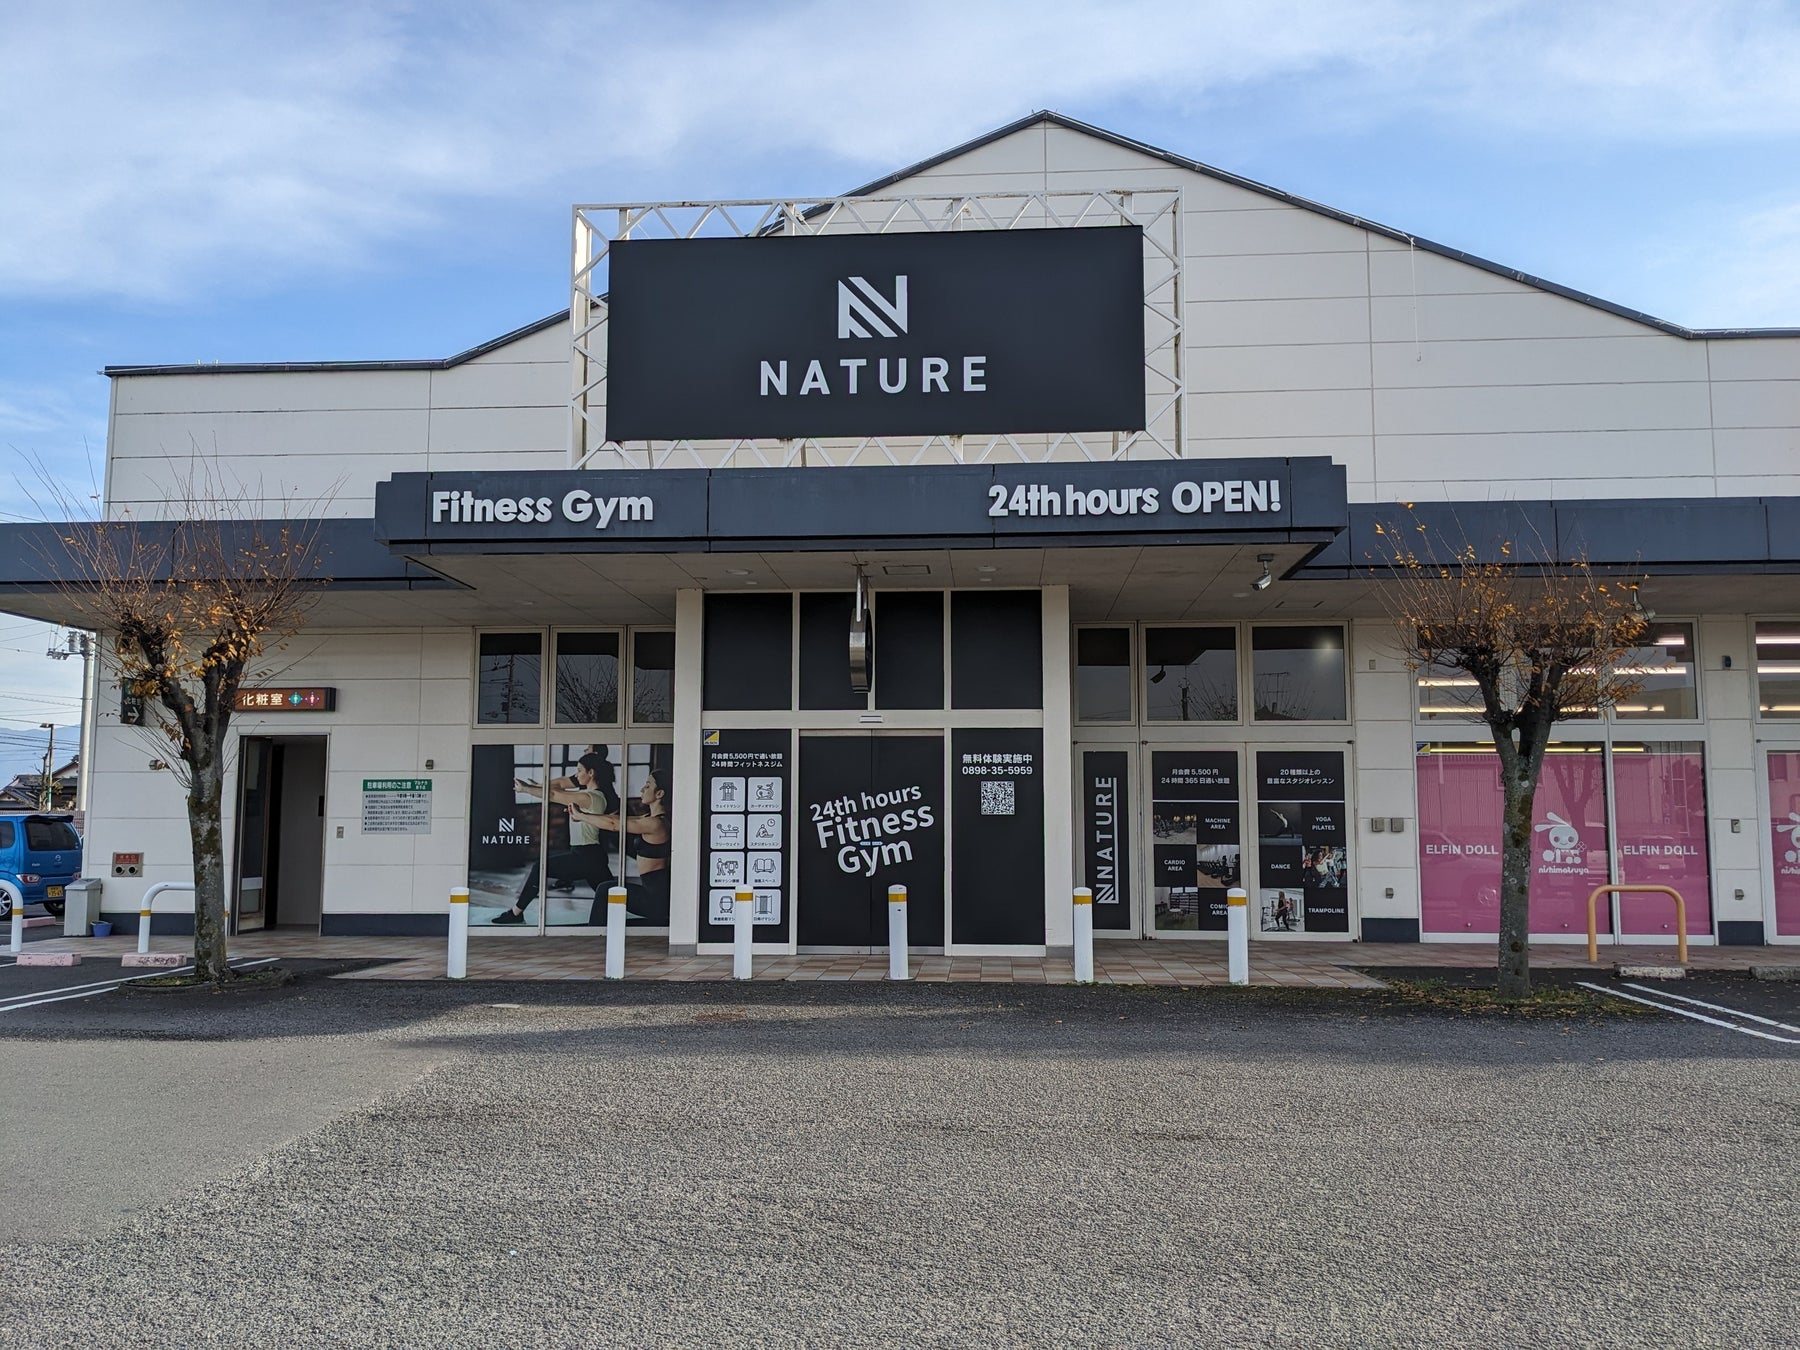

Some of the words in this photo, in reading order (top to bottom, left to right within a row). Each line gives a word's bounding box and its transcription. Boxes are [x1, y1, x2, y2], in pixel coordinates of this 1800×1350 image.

[760, 356, 987, 396] NATURE
[432, 490, 553, 523] Fitness
[562, 489, 654, 529] Gym
[988, 484, 1061, 517] 24th
[1066, 484, 1160, 516] hours
[1172, 480, 1281, 514] OPEN!
[242, 693, 283, 706] 化粧室
[962, 753, 1033, 764] 無料体験実施中
[962, 766, 1033, 775] 0898-35-5959
[809, 796, 857, 821] 24th
[861, 785, 921, 811] hours
[482, 836, 530, 844] NATURE
[816, 806, 935, 849] Fitness
[1095, 776, 1113, 879] NATURE
[837, 840, 913, 877] Gym
[1426, 844, 1461, 855] ELFIN
[1465, 844, 1499, 855] DOLL
[1623, 845, 1660, 855] ELFIN
[1664, 845, 1699, 855] DOLL
